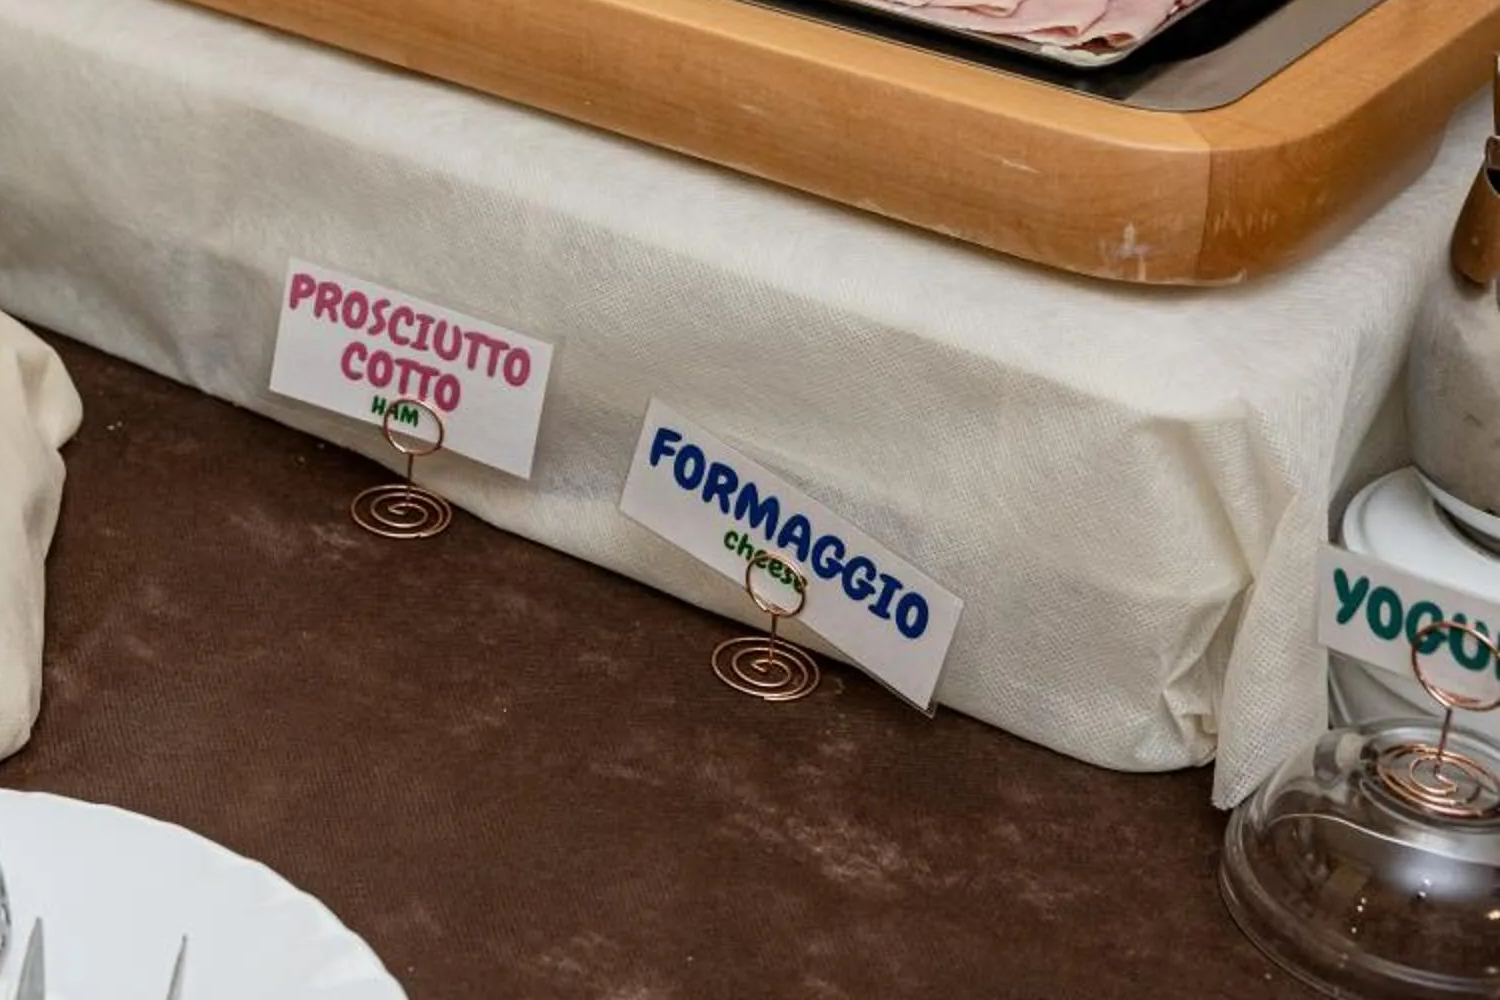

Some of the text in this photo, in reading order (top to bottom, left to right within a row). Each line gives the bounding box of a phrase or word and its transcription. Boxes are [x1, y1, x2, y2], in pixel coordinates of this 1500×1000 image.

[289, 273, 531, 387] PROSCIUTTO
[341, 341, 461, 413] COTTO
[371, 395, 419, 427] HAM
[650, 427, 929, 639] FORMAGGIO
[723, 530, 808, 593] cheese
[1333, 567, 1500, 681] YOGU
